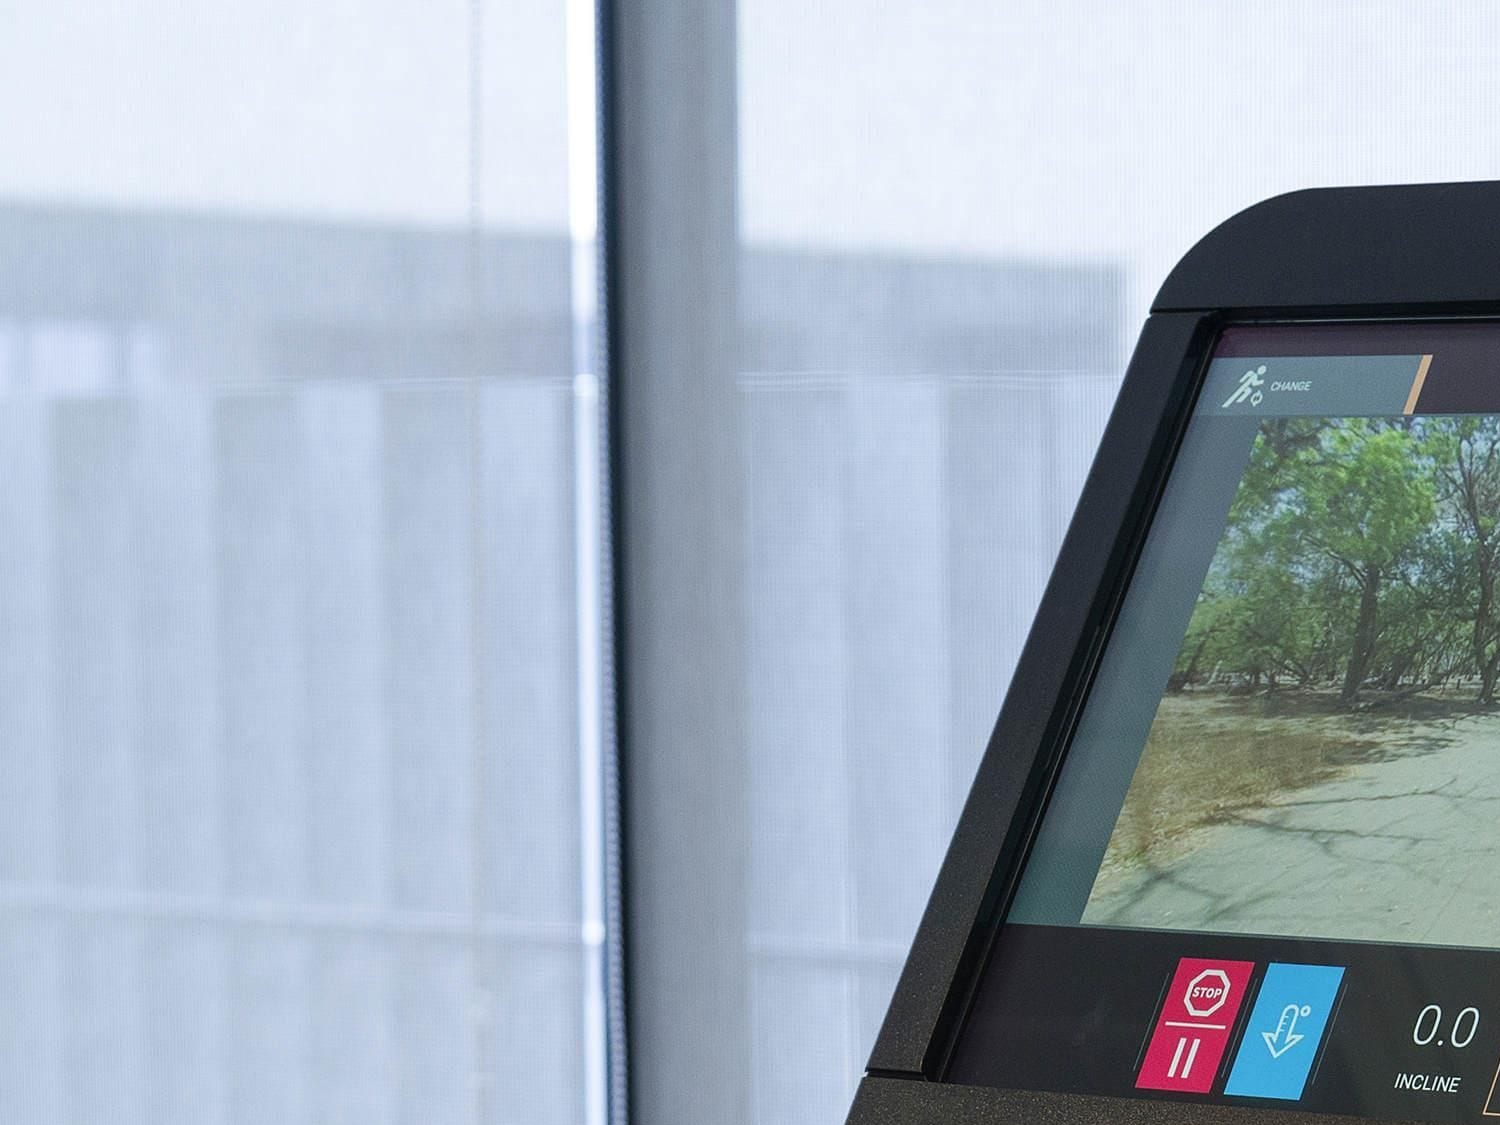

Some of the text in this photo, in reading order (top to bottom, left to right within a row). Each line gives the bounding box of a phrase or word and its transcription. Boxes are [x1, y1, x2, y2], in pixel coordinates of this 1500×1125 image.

[1270, 380, 1313, 392] CHANGE
[1192, 986, 1223, 999] STOP
[1412, 1004, 1480, 1049] 0.0
[1394, 1072, 1462, 1095] INCLINE
